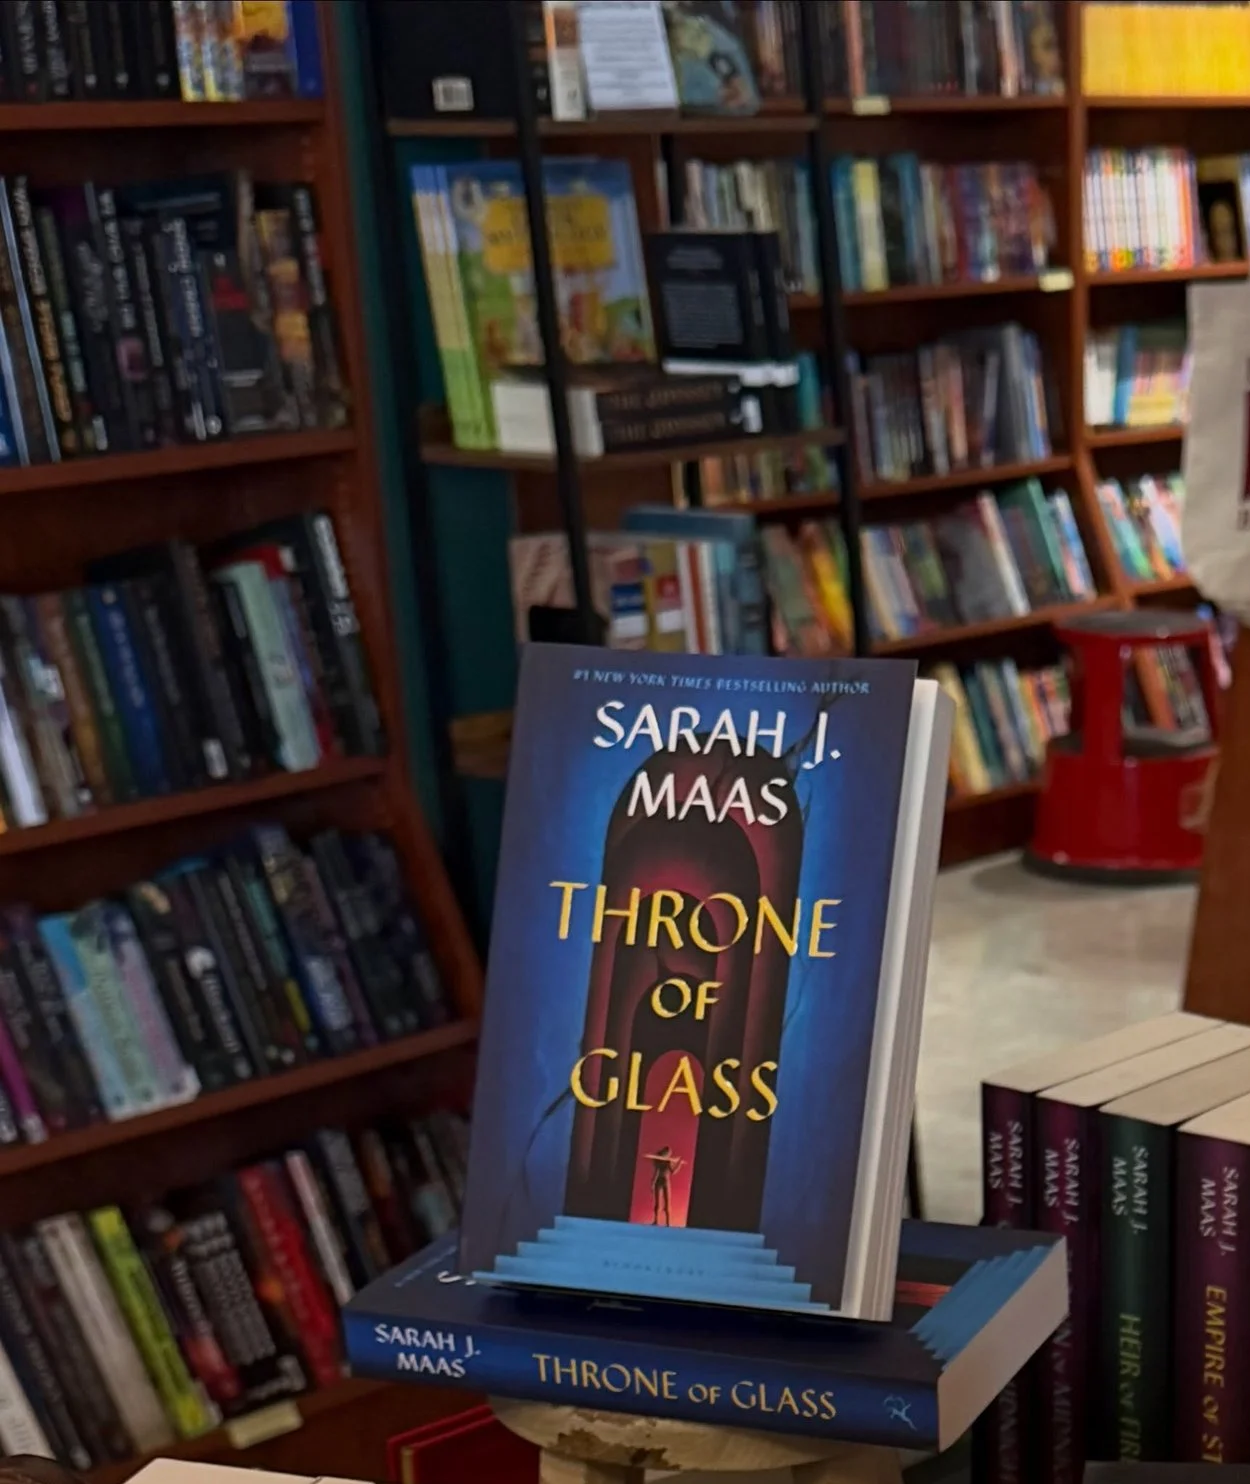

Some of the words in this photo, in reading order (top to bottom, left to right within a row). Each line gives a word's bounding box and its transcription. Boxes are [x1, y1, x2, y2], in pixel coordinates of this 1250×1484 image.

[573, 668, 590, 681] #1
[595, 670, 625, 684] NEW
[629, 673, 665, 688] YORK
[671, 675, 711, 690] TIMES
[716, 678, 806, 694] BESTSELLING
[811, 681, 871, 695] AUTHOR
[593, 700, 786, 758] SARAH
[802, 711, 841, 769] J.
[627, 770, 789, 826] MAAS
[549, 880, 842, 958] THRONE
[651, 978, 723, 1020] OF
[570, 1048, 778, 1121] GLASS
[1113, 1156, 1129, 1216] MAAS
[1132, 1145, 1148, 1215] SARAH
[1200, 1178, 1216, 1238] MAAS
[1223, 1166, 1239, 1242] SARAH
[374, 1323, 455, 1352] SARAH
[464, 1336, 482, 1357] J.
[396, 1352, 467, 1378] MAAS
[1119, 1313, 1142, 1377] HEIR
[1204, 1285, 1227, 1388] EMPIRE
[532, 1353, 678, 1399] THRONE
[688, 1383, 721, 1404] OF
[732, 1380, 837, 1420] GLASS
